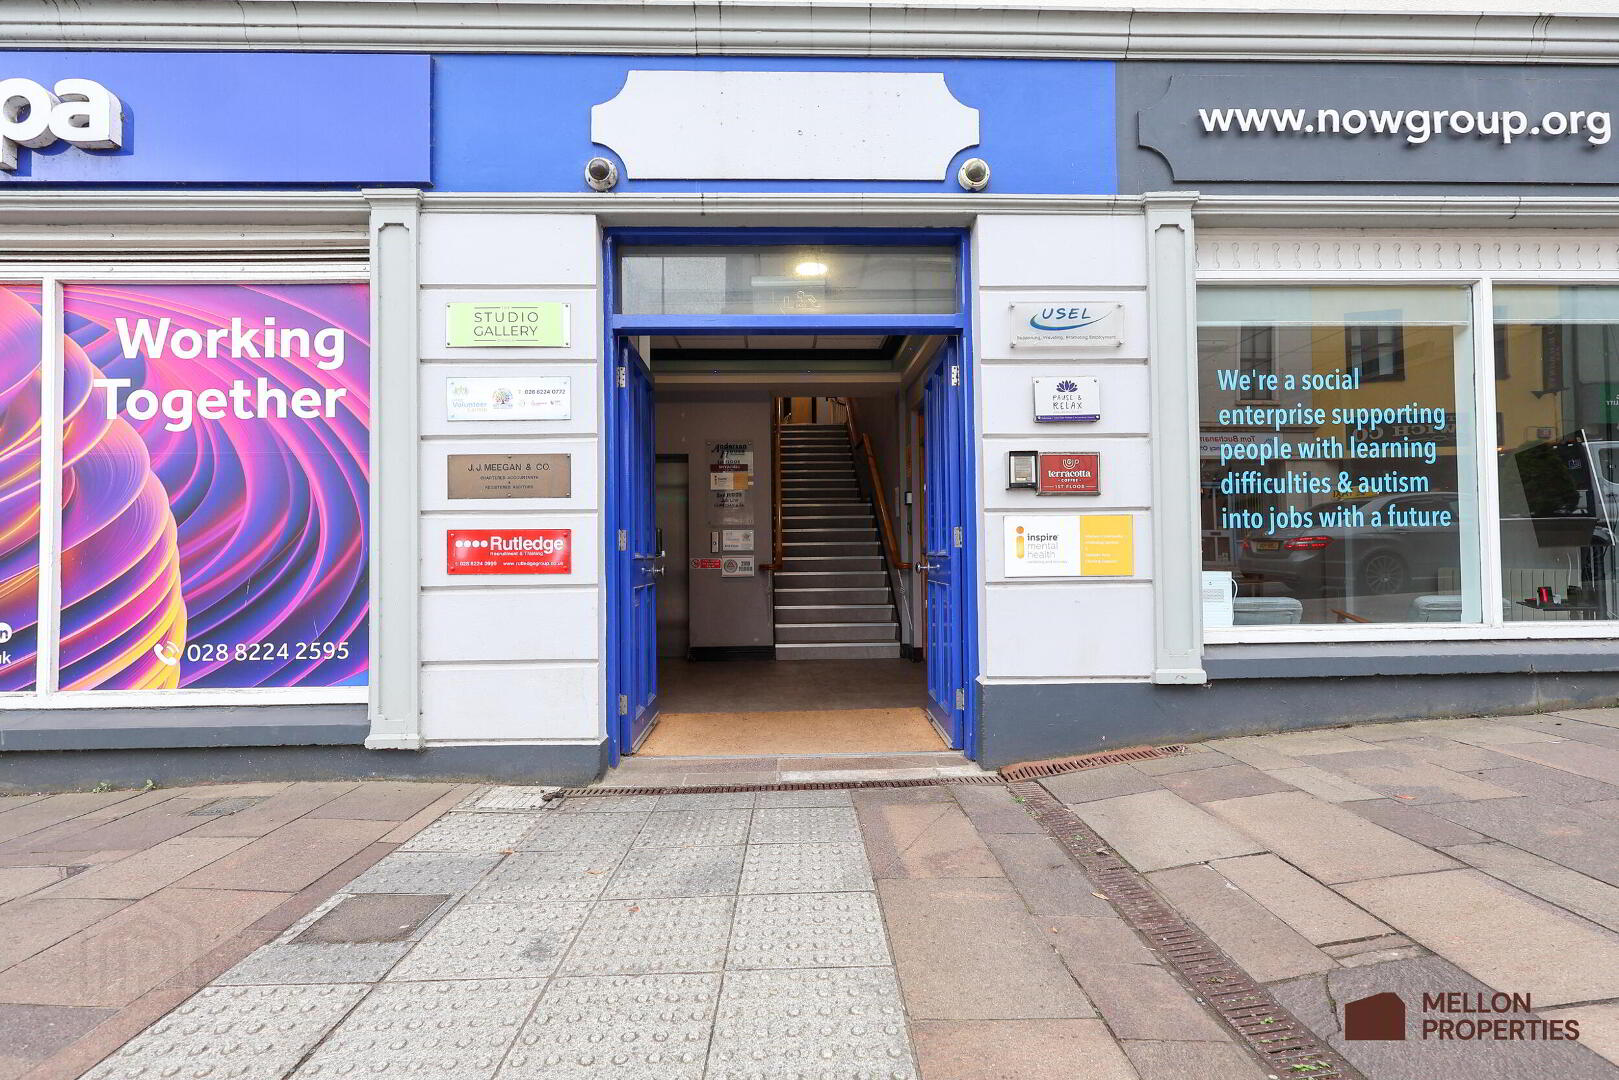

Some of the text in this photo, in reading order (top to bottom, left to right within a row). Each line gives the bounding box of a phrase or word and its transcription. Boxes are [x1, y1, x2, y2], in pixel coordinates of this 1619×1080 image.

[1198, 107, 1611, 145] www.nowgroup.org
[474, 312, 539, 323] STUDIO
[1042, 307, 1091, 319] USEL
[473, 325, 538, 337] GALLERY
[115, 317, 345, 371] Working
[1217, 368, 1359, 391] We're a social
[93, 377, 347, 432] Together
[1052, 402, 1083, 410] RELAX
[1219, 402, 1445, 431] enterprise supporting
[1220, 436, 1437, 466] people with learning
[484, 463, 522, 471] MEEGAN
[525, 463, 532, 471] &
[1048, 469, 1091, 478] terracotta
[1220, 470, 1429, 495] difficulties & autism
[1222, 503, 1451, 535] into jobs with a future
[490, 536, 564, 554] Rutledge
[1027, 533, 1058, 542] inspire
[1027, 542, 1058, 550] mental
[1027, 550, 1056, 559] health
[187, 641, 349, 662] 028 8224 2595
